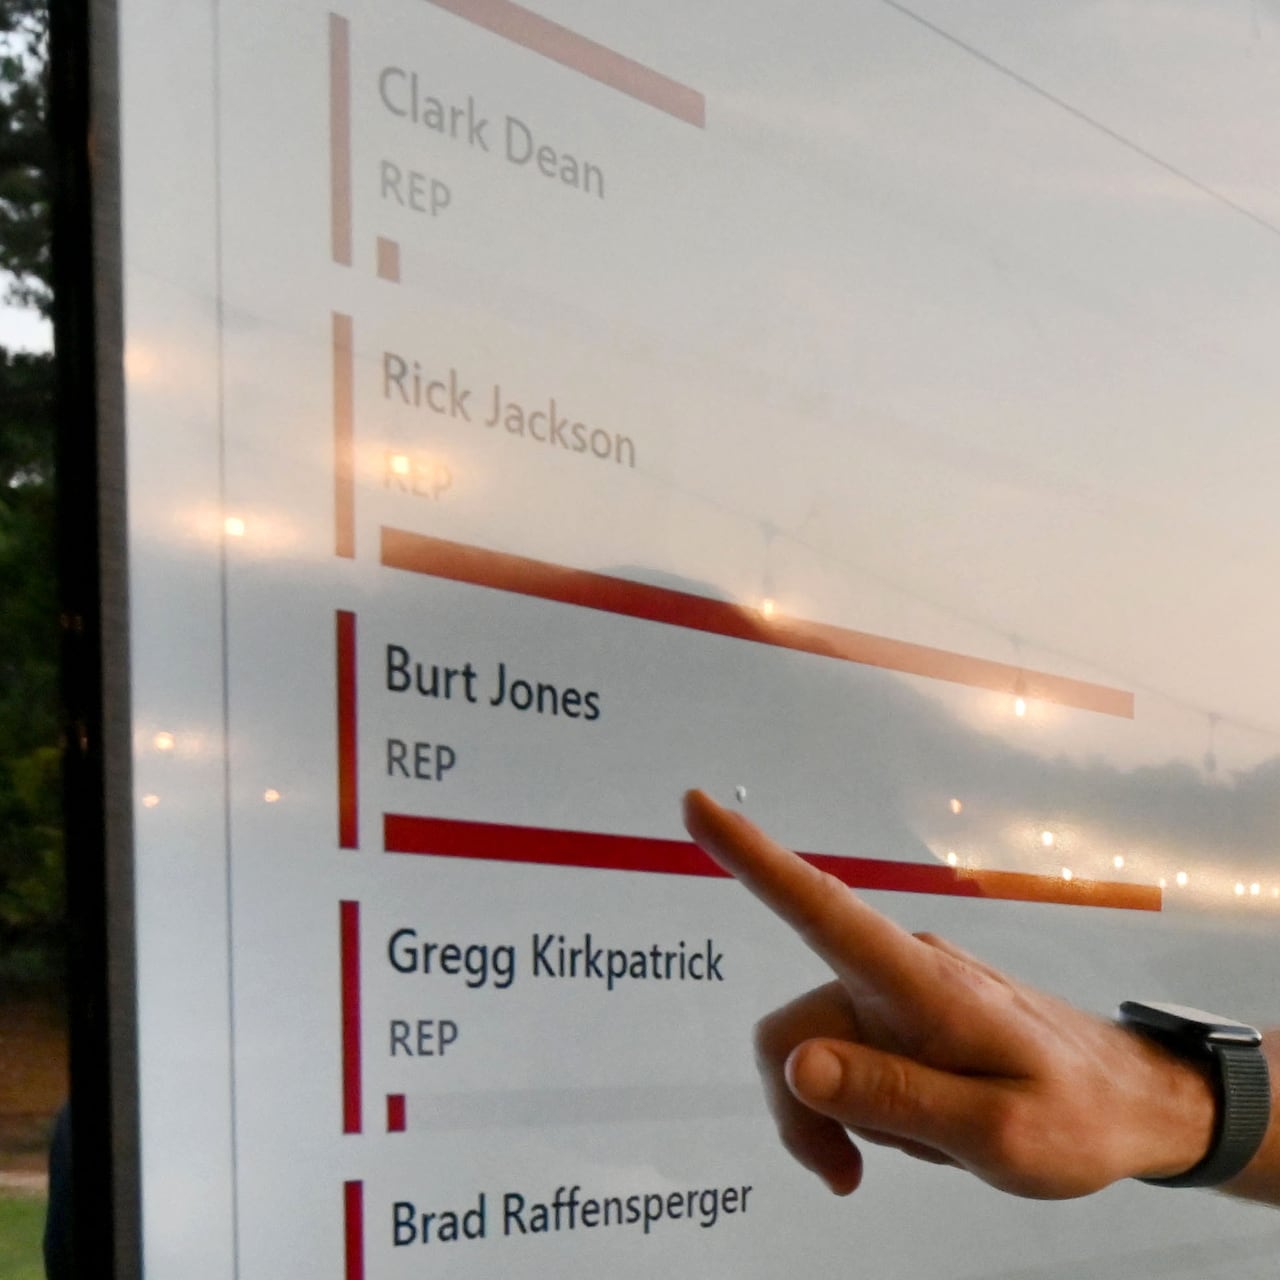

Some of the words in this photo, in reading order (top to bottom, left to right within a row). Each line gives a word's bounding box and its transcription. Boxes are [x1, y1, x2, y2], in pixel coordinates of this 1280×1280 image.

[378, 66, 490, 152] Clark
[505, 115, 605, 198] Dean
[380, 160, 452, 216] REP
[382, 351, 471, 422] Rick
[484, 385, 636, 468] Jackson
[386, 644, 477, 702] Burt
[490, 663, 600, 720] Jones
[387, 738, 456, 782] REP
[388, 928, 515, 988] Gregg
[533, 934, 724, 990] Kirkpatrick
[389, 1020, 458, 1056] REP
[393, 1192, 486, 1247] Brad
[503, 1184, 752, 1236] Raffensperger
